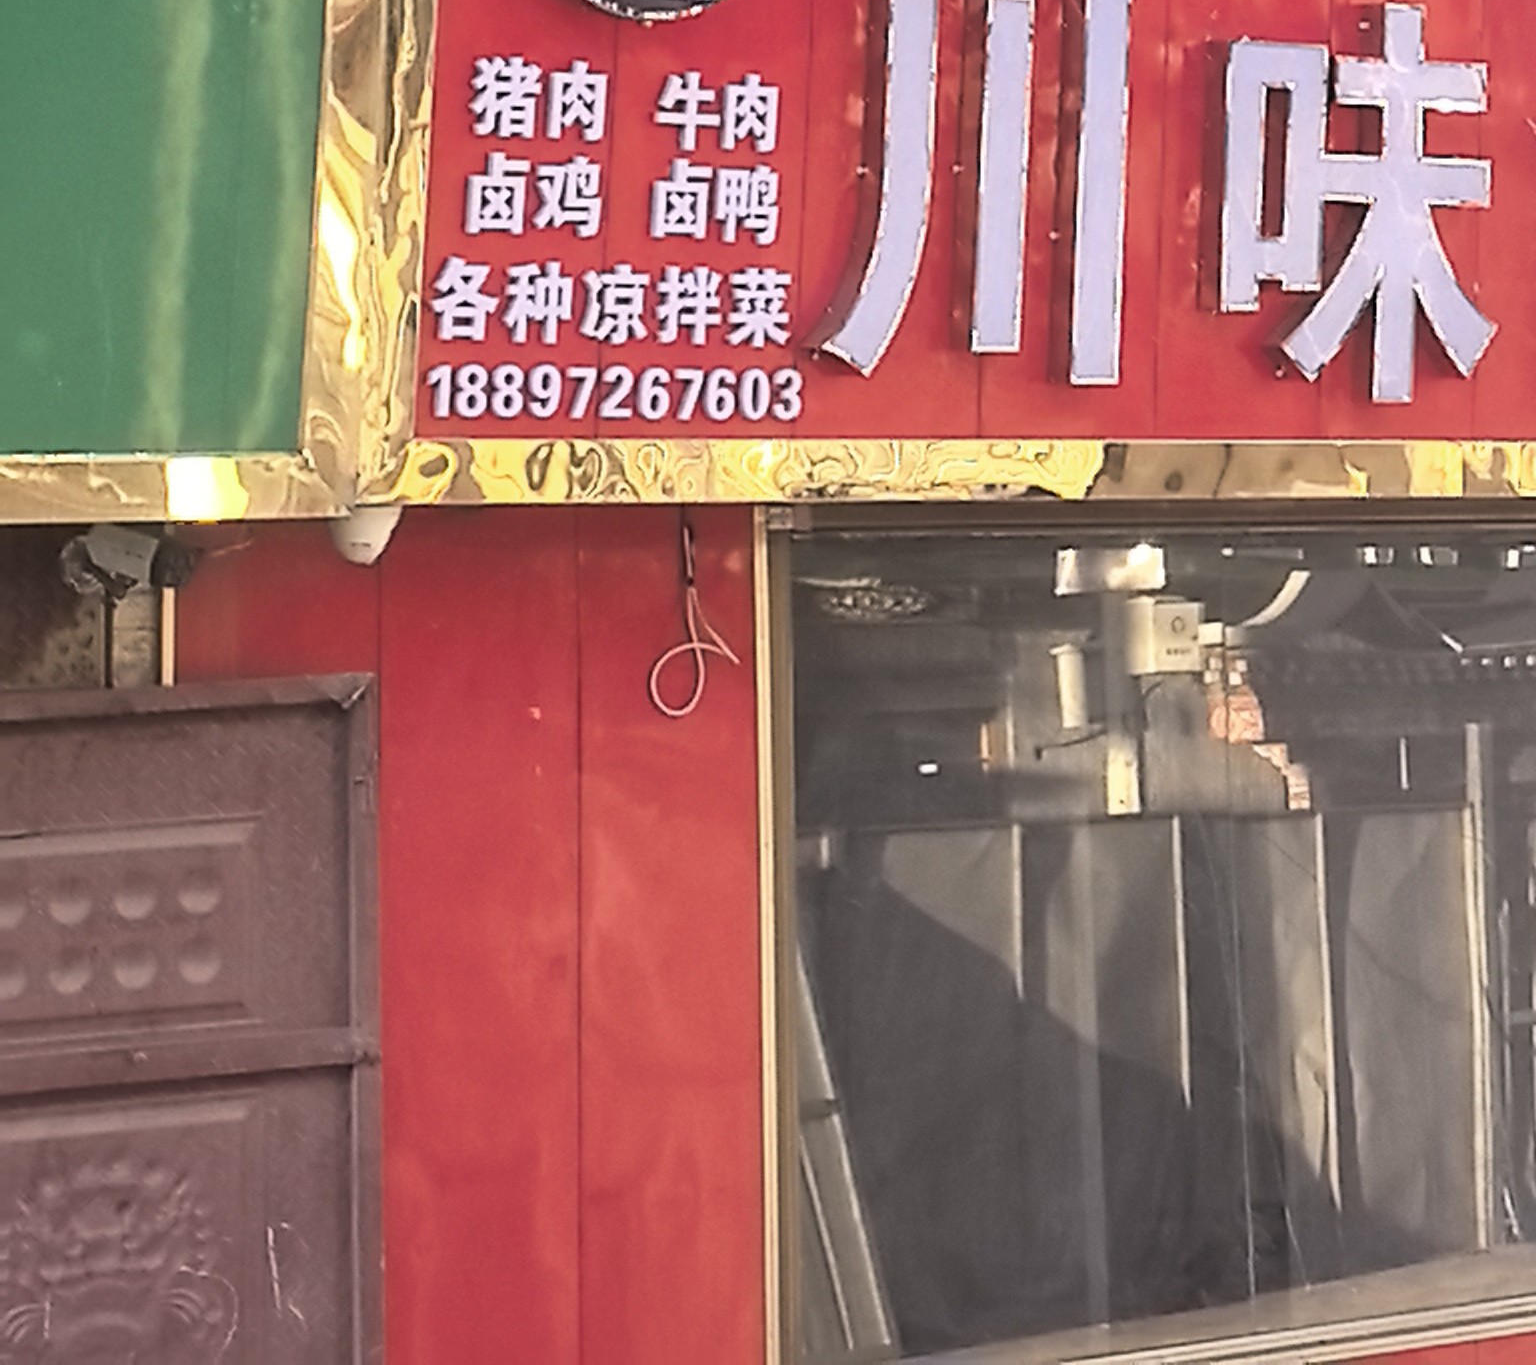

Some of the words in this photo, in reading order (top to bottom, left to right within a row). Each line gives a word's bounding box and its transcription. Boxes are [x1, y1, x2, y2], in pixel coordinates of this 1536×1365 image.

[470, 55, 608, 142] 猪肉
[654, 71, 780, 155] 牛肉
[464, 153, 602, 241] 卤鸡
[650, 160, 780, 247] 卤鸭
[432, 255, 792, 351] 各种凉拌菜
[428, 365, 803, 422] 18897267603
